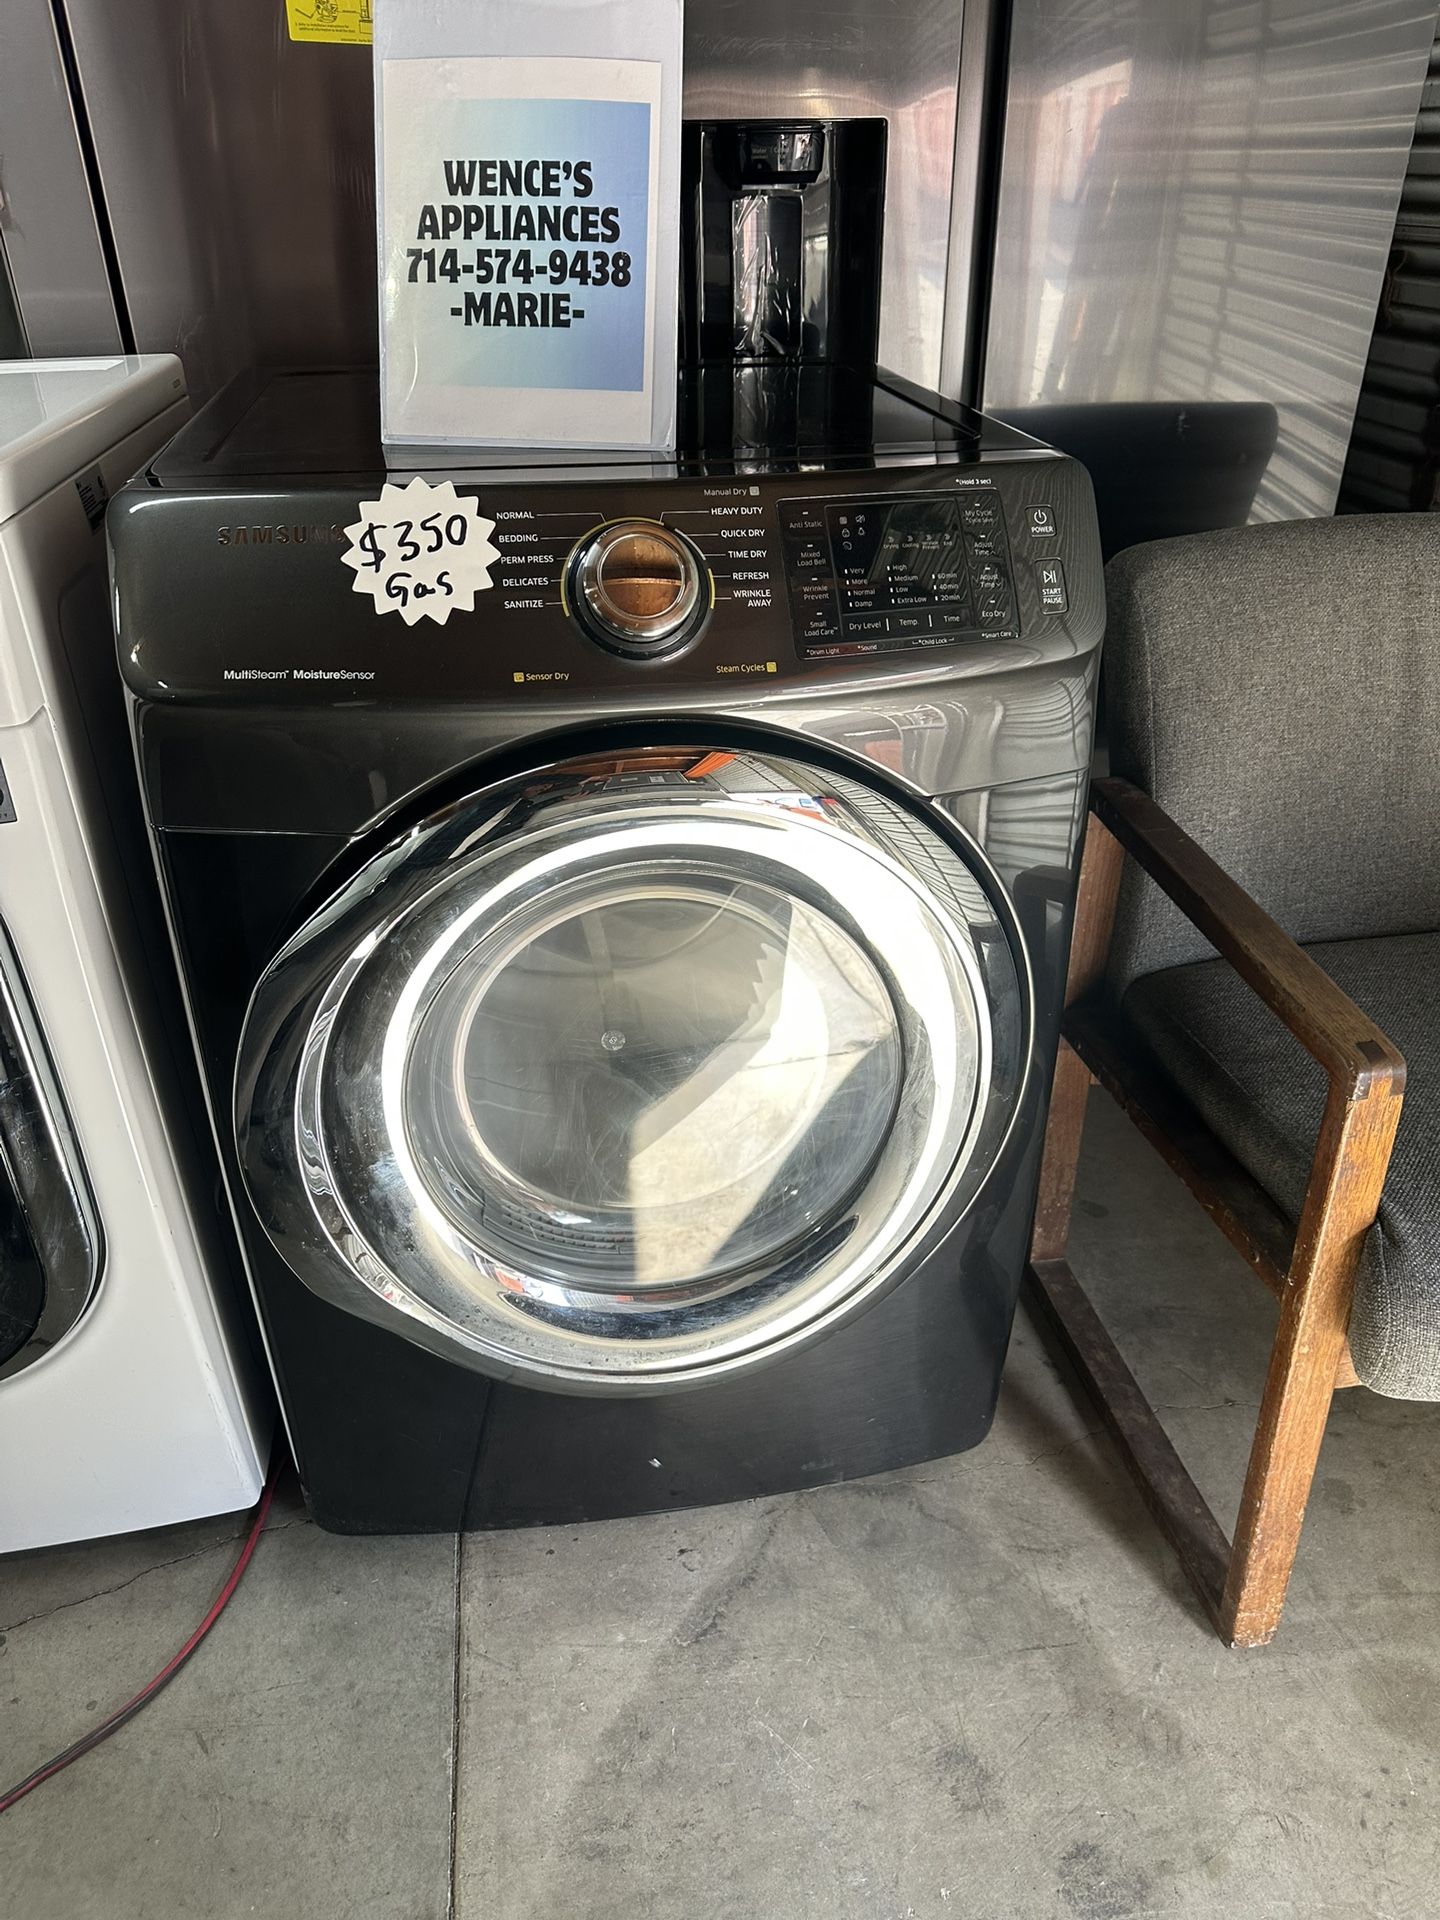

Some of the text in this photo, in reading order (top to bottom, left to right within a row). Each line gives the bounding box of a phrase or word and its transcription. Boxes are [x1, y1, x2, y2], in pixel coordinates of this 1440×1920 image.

[443, 160, 593, 198] WENCE'S
[417, 205, 620, 243] APPLIANCES
[406, 248, 631, 287] 714-574-9438
[450, 291, 585, 328] -MARIE-
[703, 488, 747, 496] Manual Dry
[496, 511, 535, 520] NORMAL
[711, 506, 763, 516] HEAVY DUTY
[789, 520, 823, 529] Anti Static
[1031, 525, 1054, 533] POWER
[720, 529, 766, 538] QUICK DRY
[359, 512, 468, 573] $350
[498, 534, 539, 543] BEDDING
[728, 550, 767, 559] TIME DRY
[500, 555, 554, 565] PERM PRESS
[797, 558, 826, 567] Load Bell
[849, 568, 865, 576] Very
[892, 564, 908, 572] High
[732, 571, 770, 580] REFRESH
[502, 577, 549, 587] DELICATES
[385, 571, 454, 607] Gas
[802, 584, 828, 592] Wrinkle
[853, 588, 876, 596] Normal
[1042, 587, 1061, 595] START
[733, 588, 772, 598] WRINKLE
[803, 592, 830, 600] Prevent
[504, 599, 544, 609] SANITIZE
[747, 599, 772, 608] AWAY
[854, 600, 873, 608] Damp
[982, 609, 1006, 618] Eco Dry
[809, 620, 828, 628] Small
[849, 620, 882, 631] Dry Level
[804, 629, 820, 637] Load
[826, 647, 840, 655] Light
[716, 663, 765, 674] Steam Cycles
[293, 669, 375, 680] MoistureSensor
[525, 671, 570, 681] Sensor Dry
